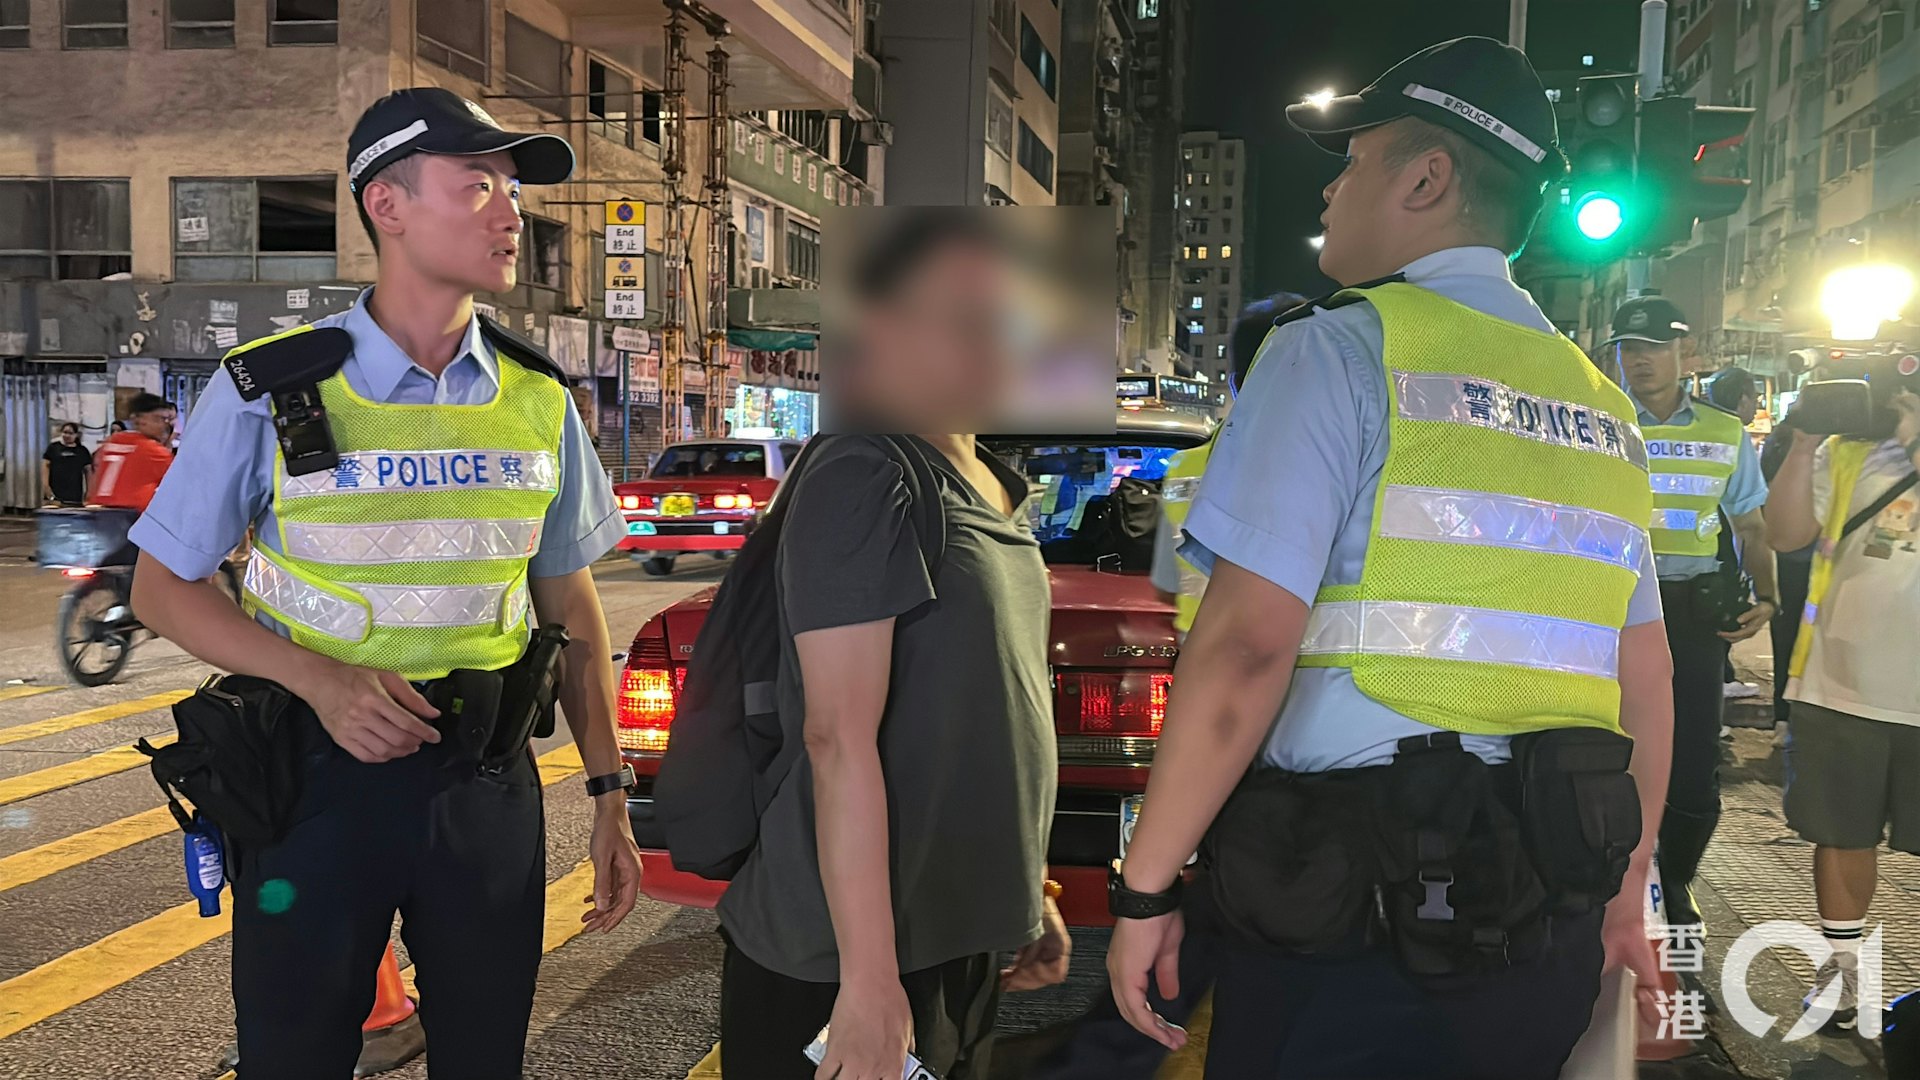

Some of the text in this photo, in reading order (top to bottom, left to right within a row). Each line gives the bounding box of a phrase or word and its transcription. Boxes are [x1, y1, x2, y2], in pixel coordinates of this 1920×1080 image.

[1453, 101, 1494, 128] POLICE
[616, 228, 634, 236] End
[613, 240, 637, 250] 終止
[616, 293, 634, 301] End
[612, 304, 636, 315] 終止
[230, 359, 256, 392] 26424
[1463, 382, 1492, 421] 警
[1646, 442, 1694, 457] OLICE
[335, 455, 522, 488] 警 POLICE 察
